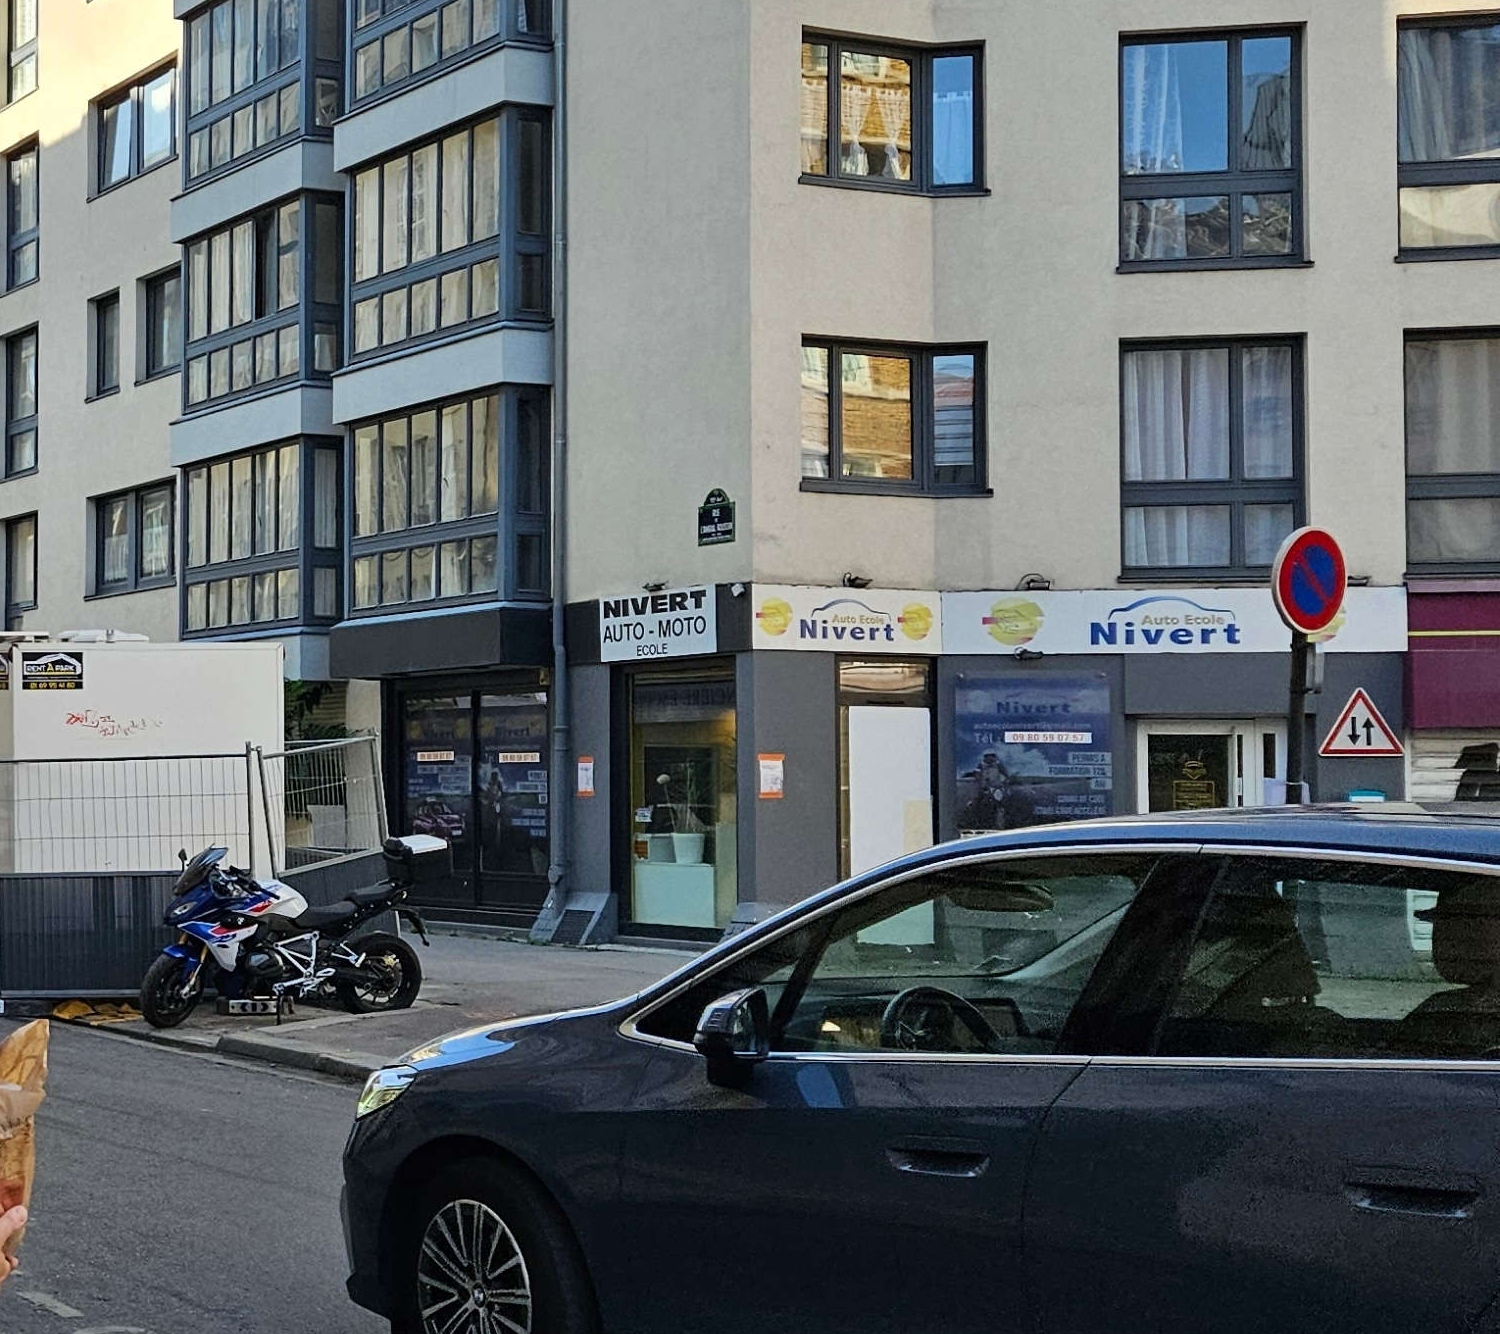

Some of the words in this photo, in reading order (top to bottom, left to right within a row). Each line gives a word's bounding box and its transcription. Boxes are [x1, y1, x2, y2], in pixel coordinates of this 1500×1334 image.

[603, 589, 707, 619] NIVERT
[831, 614, 858, 624] Auto
[859, 614, 885, 625] Ecole
[1140, 615, 1180, 626] Auto
[1184, 614, 1225, 625] Ecole
[603, 622, 645, 644] AUTO
[658, 615, 707, 638] MOTO
[799, 619, 895, 642] Nivert
[1090, 621, 1241, 646] Nivert
[636, 643, 668, 657] ECOLE
[46, 663, 54, 672] A
[996, 701, 1072, 714] Nivert
[1012, 733, 1025, 742] 09
[1027, 733, 1040, 742] 80
[1042, 733, 1055, 742] 59
[1057, 733, 1070, 742] 07
[1072, 733, 1085, 742] 57
